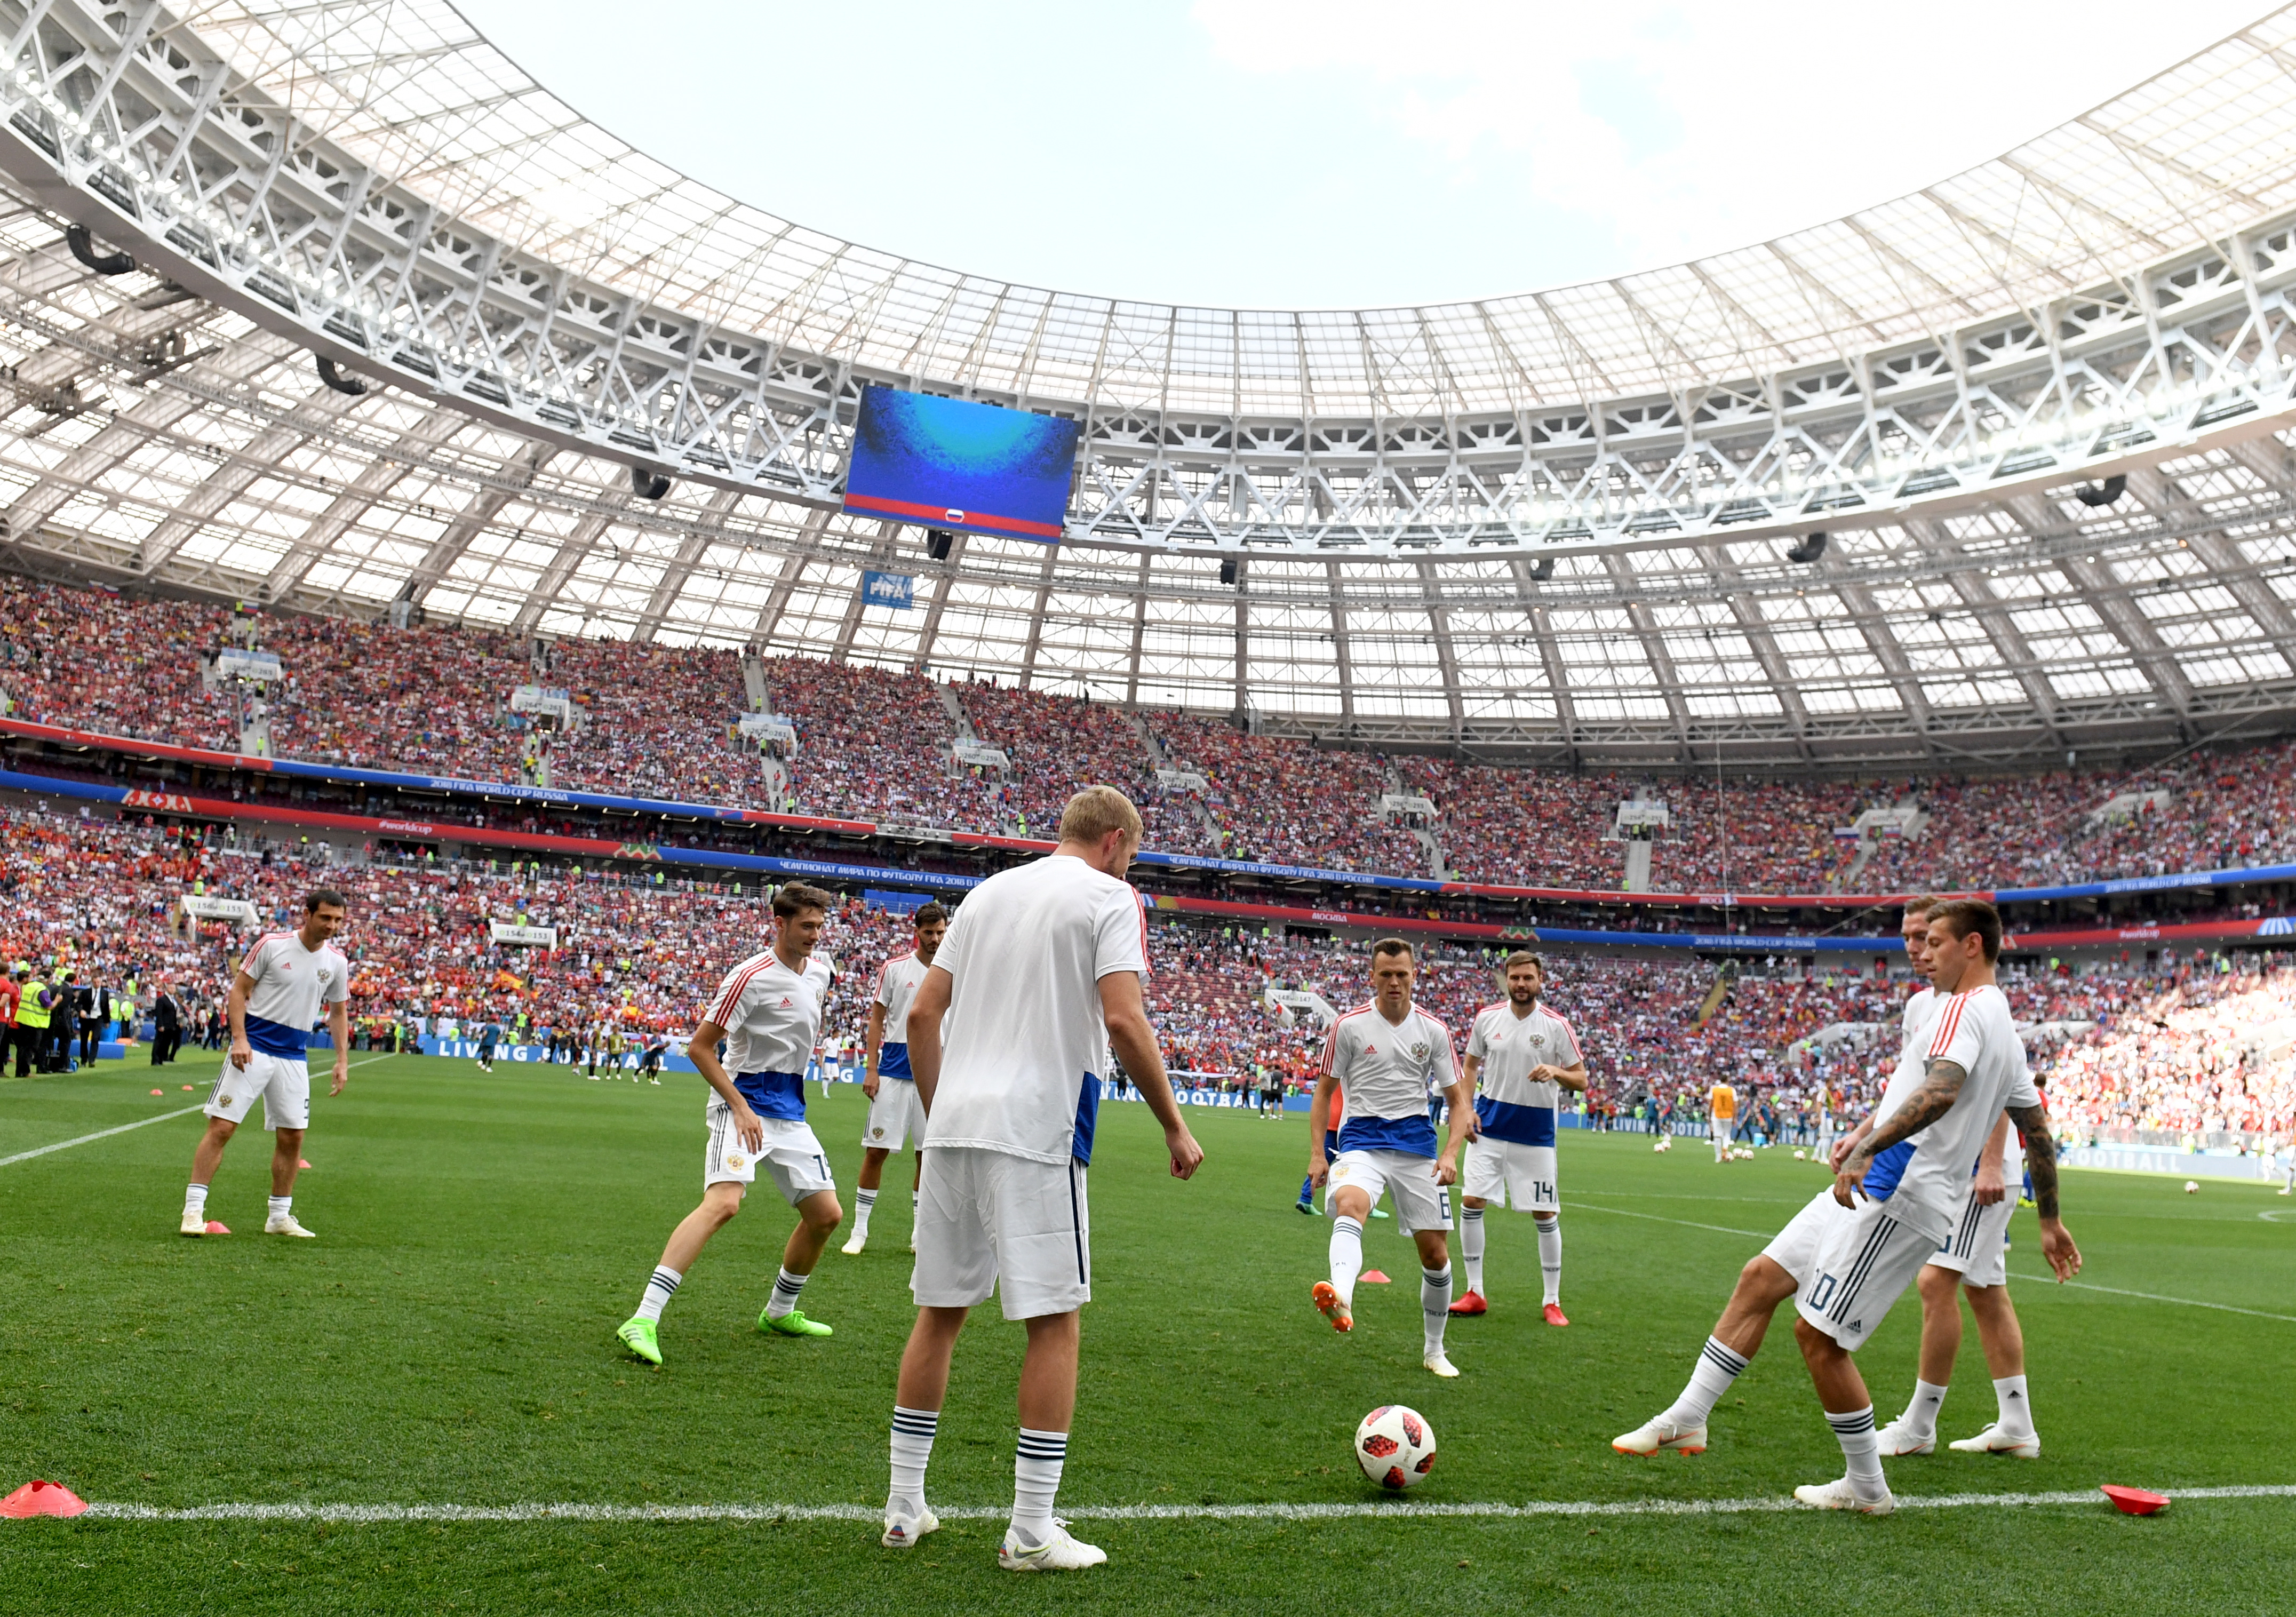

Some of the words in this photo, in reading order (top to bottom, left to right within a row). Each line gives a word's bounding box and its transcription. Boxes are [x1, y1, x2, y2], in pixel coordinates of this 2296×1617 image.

[870, 581, 905, 599] FIFA
[475, 784, 510, 796] WORLD
[511, 787, 532, 797] CUP
[532, 790, 568, 801] RUSSIA
[379, 820, 432, 835] #worldcup
[780, 861, 836, 873] ЧЕМПИОНАТ
[838, 866, 865, 877] МИРА
[866, 869, 880, 878] ПО
[881, 871, 923, 881] ФУТБОЛУ
[925, 875, 944, 884] FIFA
[945, 877, 965, 886] 2018
[1169, 856, 1219, 869] ЧЕМПИОНАТ
[1222, 861, 1245, 871] МИРА
[1247, 864, 1259, 872] ПО
[1260, 866, 1297, 876] ФУТБОЛУ
[1298, 869, 1316, 878] FIFA
[1312, 912, 1347, 922] МОСКВА
[439, 1041, 528, 1062] LIVNG
[1533, 1181, 1552, 1202] 14
